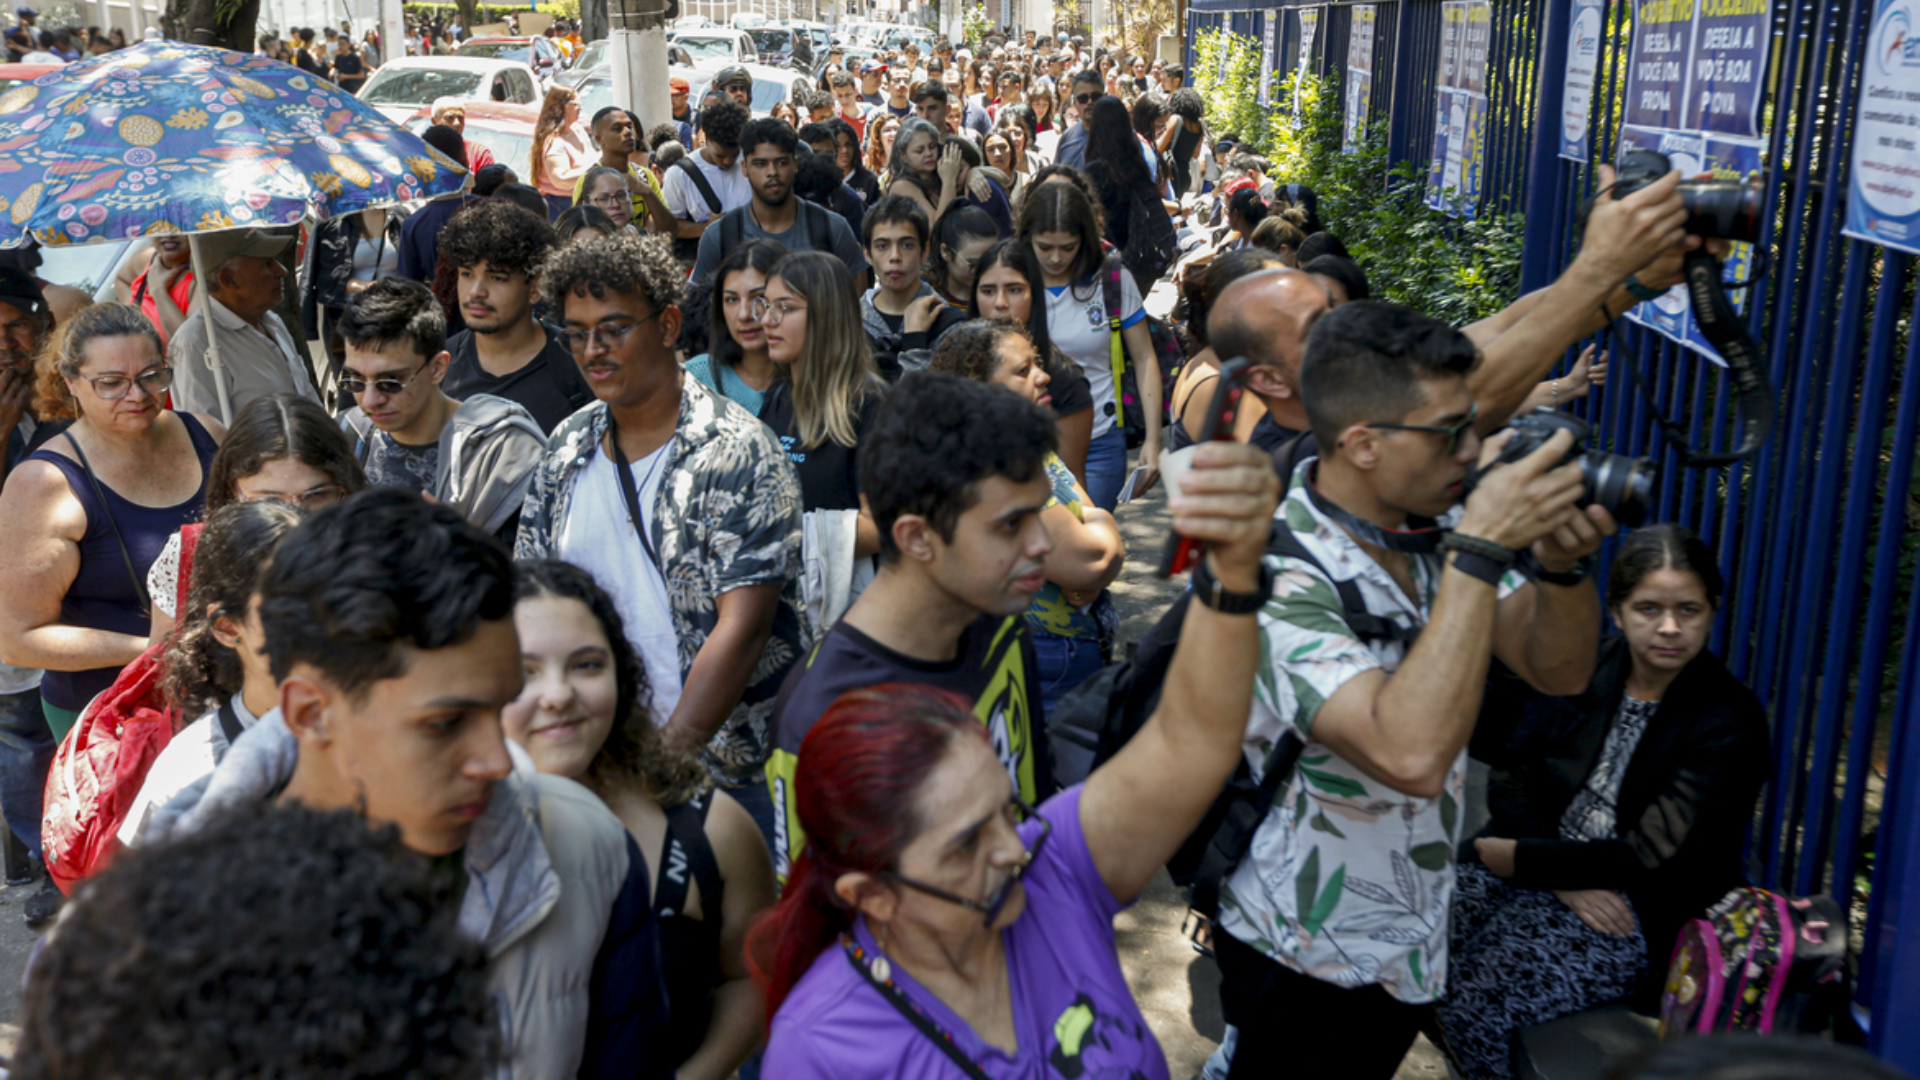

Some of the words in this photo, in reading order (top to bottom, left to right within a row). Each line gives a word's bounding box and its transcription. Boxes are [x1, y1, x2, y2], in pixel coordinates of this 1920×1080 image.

[1743, 26, 1755, 49] A
[1725, 59, 1752, 83] BOA
[1700, 91, 1735, 115] POVA
